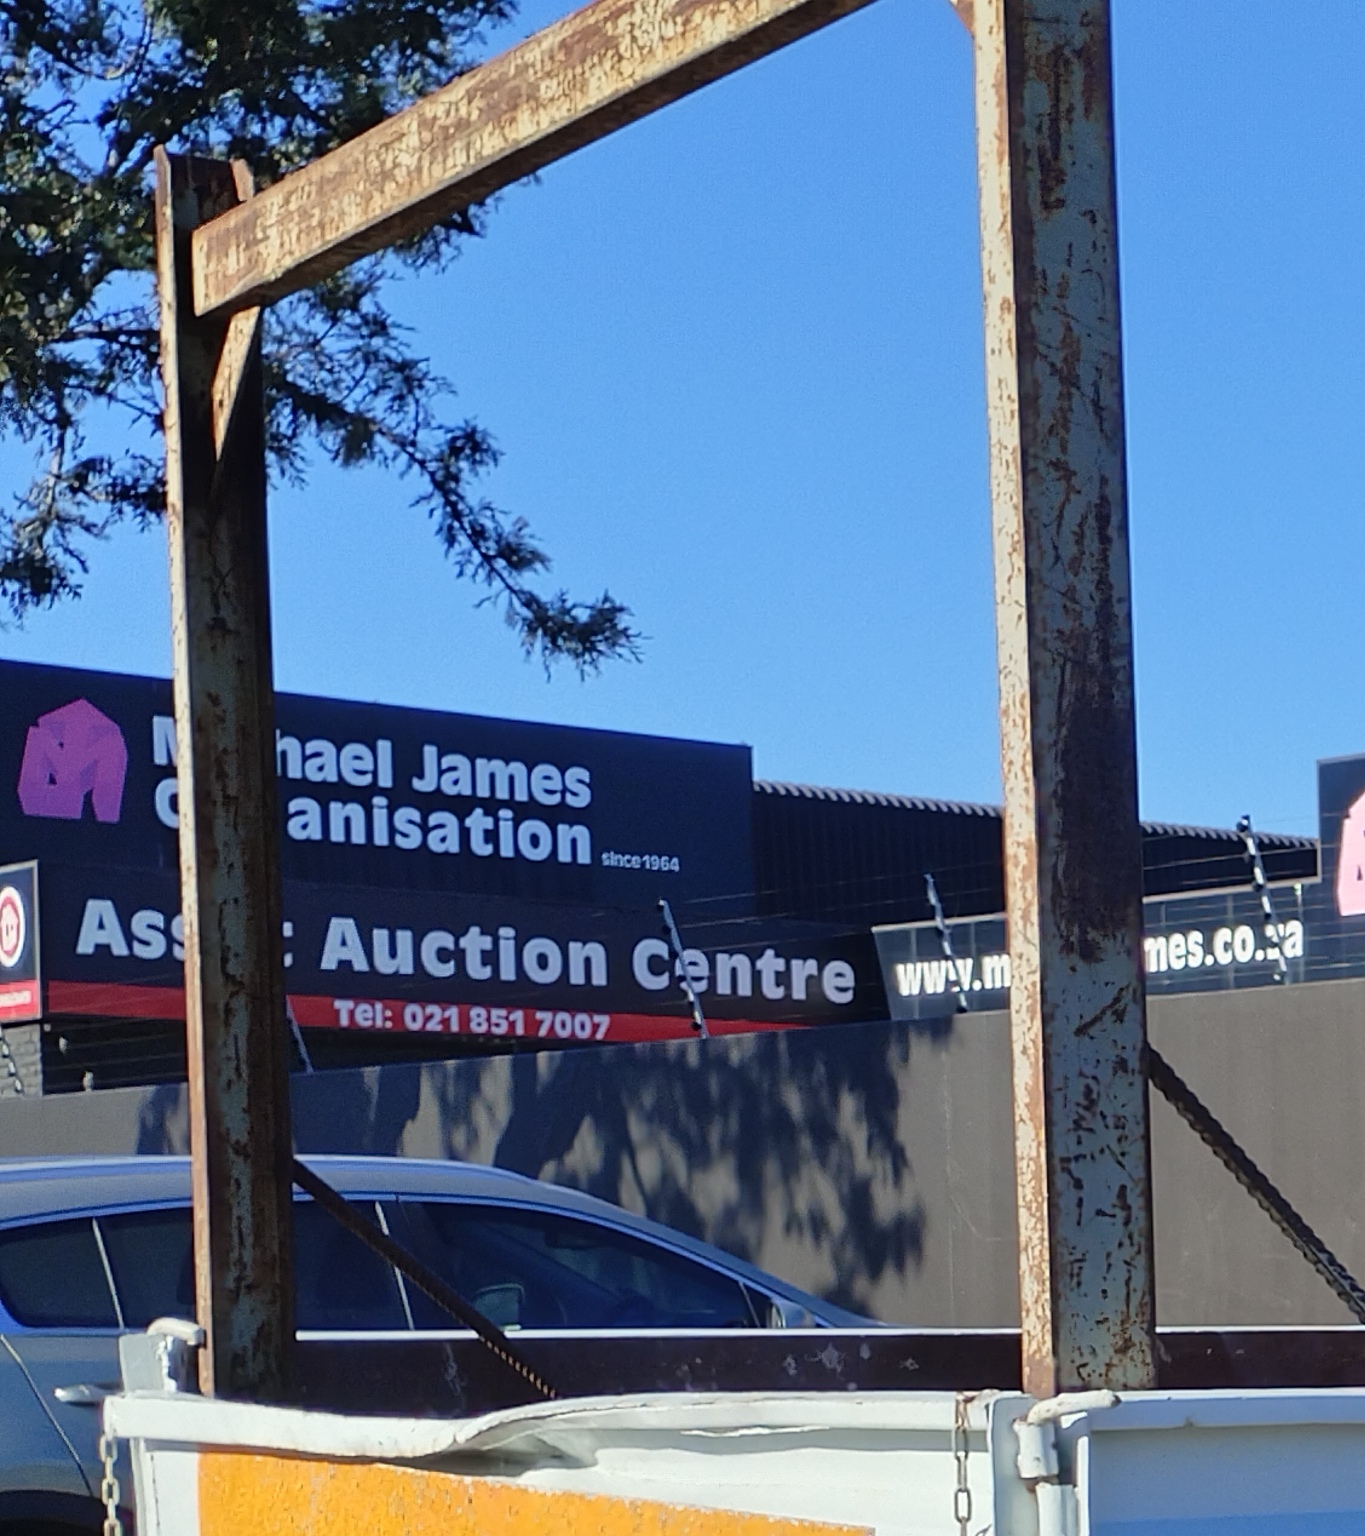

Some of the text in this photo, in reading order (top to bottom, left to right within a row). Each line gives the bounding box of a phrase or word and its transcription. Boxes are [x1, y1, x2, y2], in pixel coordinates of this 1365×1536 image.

[411, 744, 592, 808] James
[320, 916, 608, 986] Auction
[632, 937, 857, 1003] Centre
[333, 998, 610, 1040] Tel: 021 851 7007
